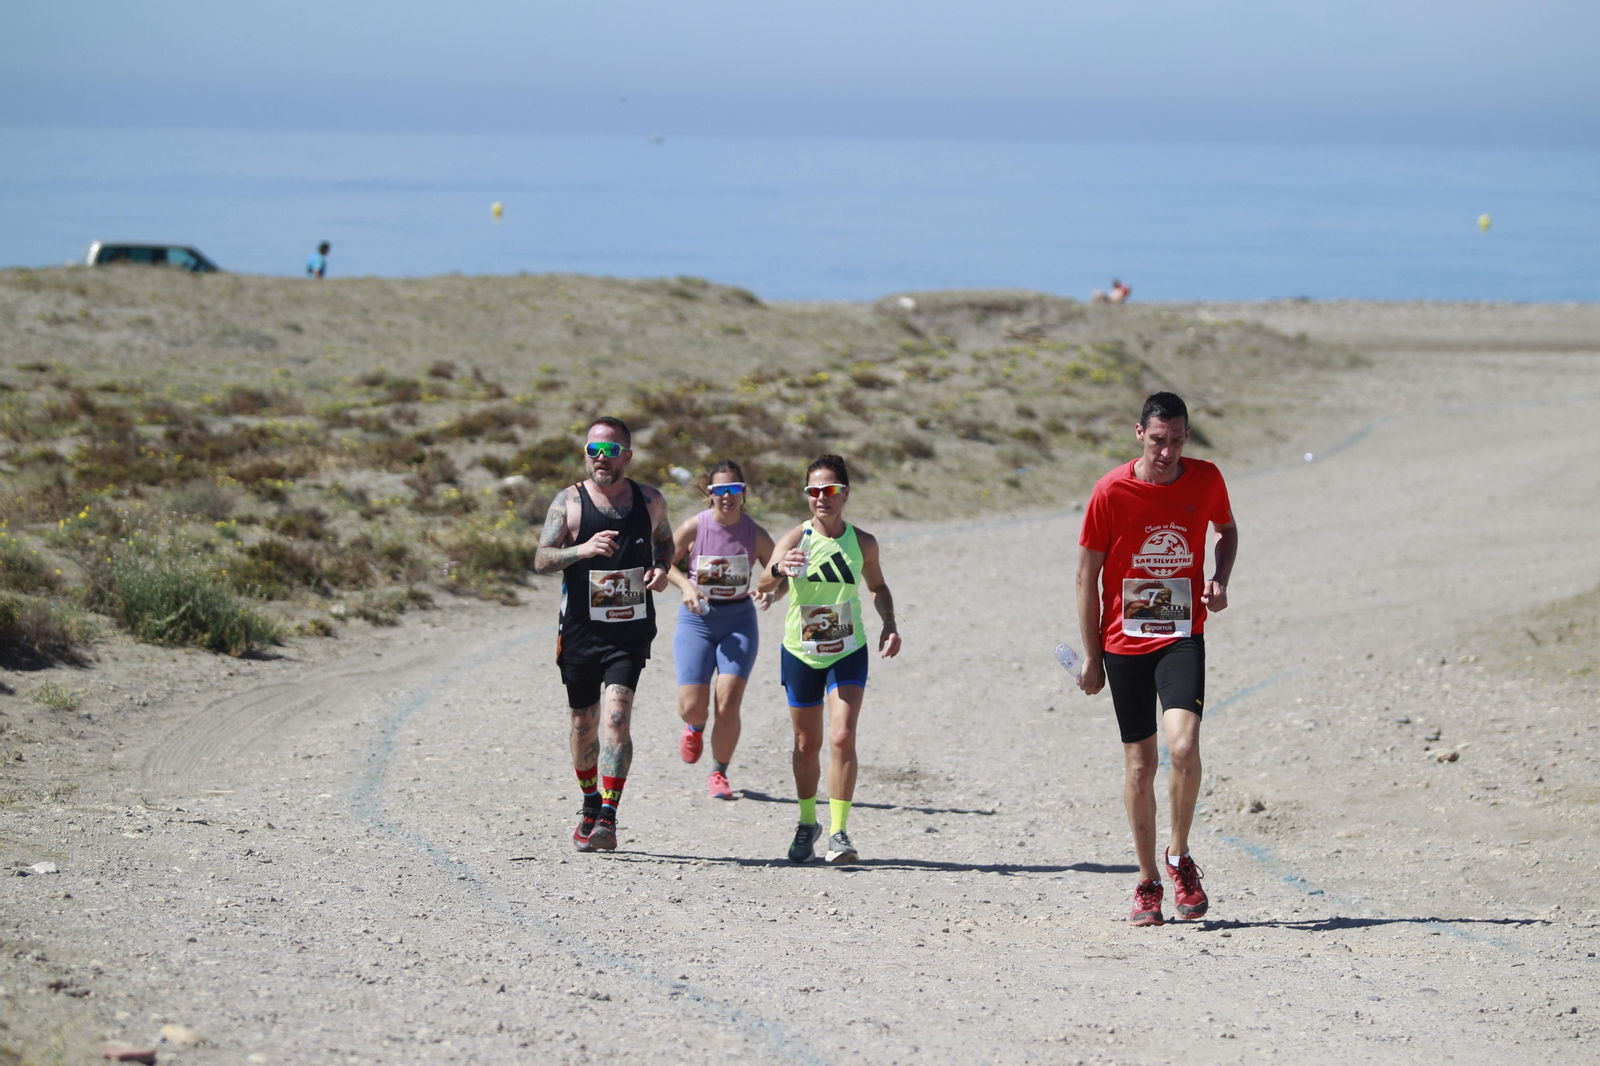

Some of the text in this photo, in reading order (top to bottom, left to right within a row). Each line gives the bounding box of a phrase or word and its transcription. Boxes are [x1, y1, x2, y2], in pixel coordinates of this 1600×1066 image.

[603, 579, 628, 597] 54
[1148, 588, 1159, 607] 7
[819, 613, 830, 630] 5
